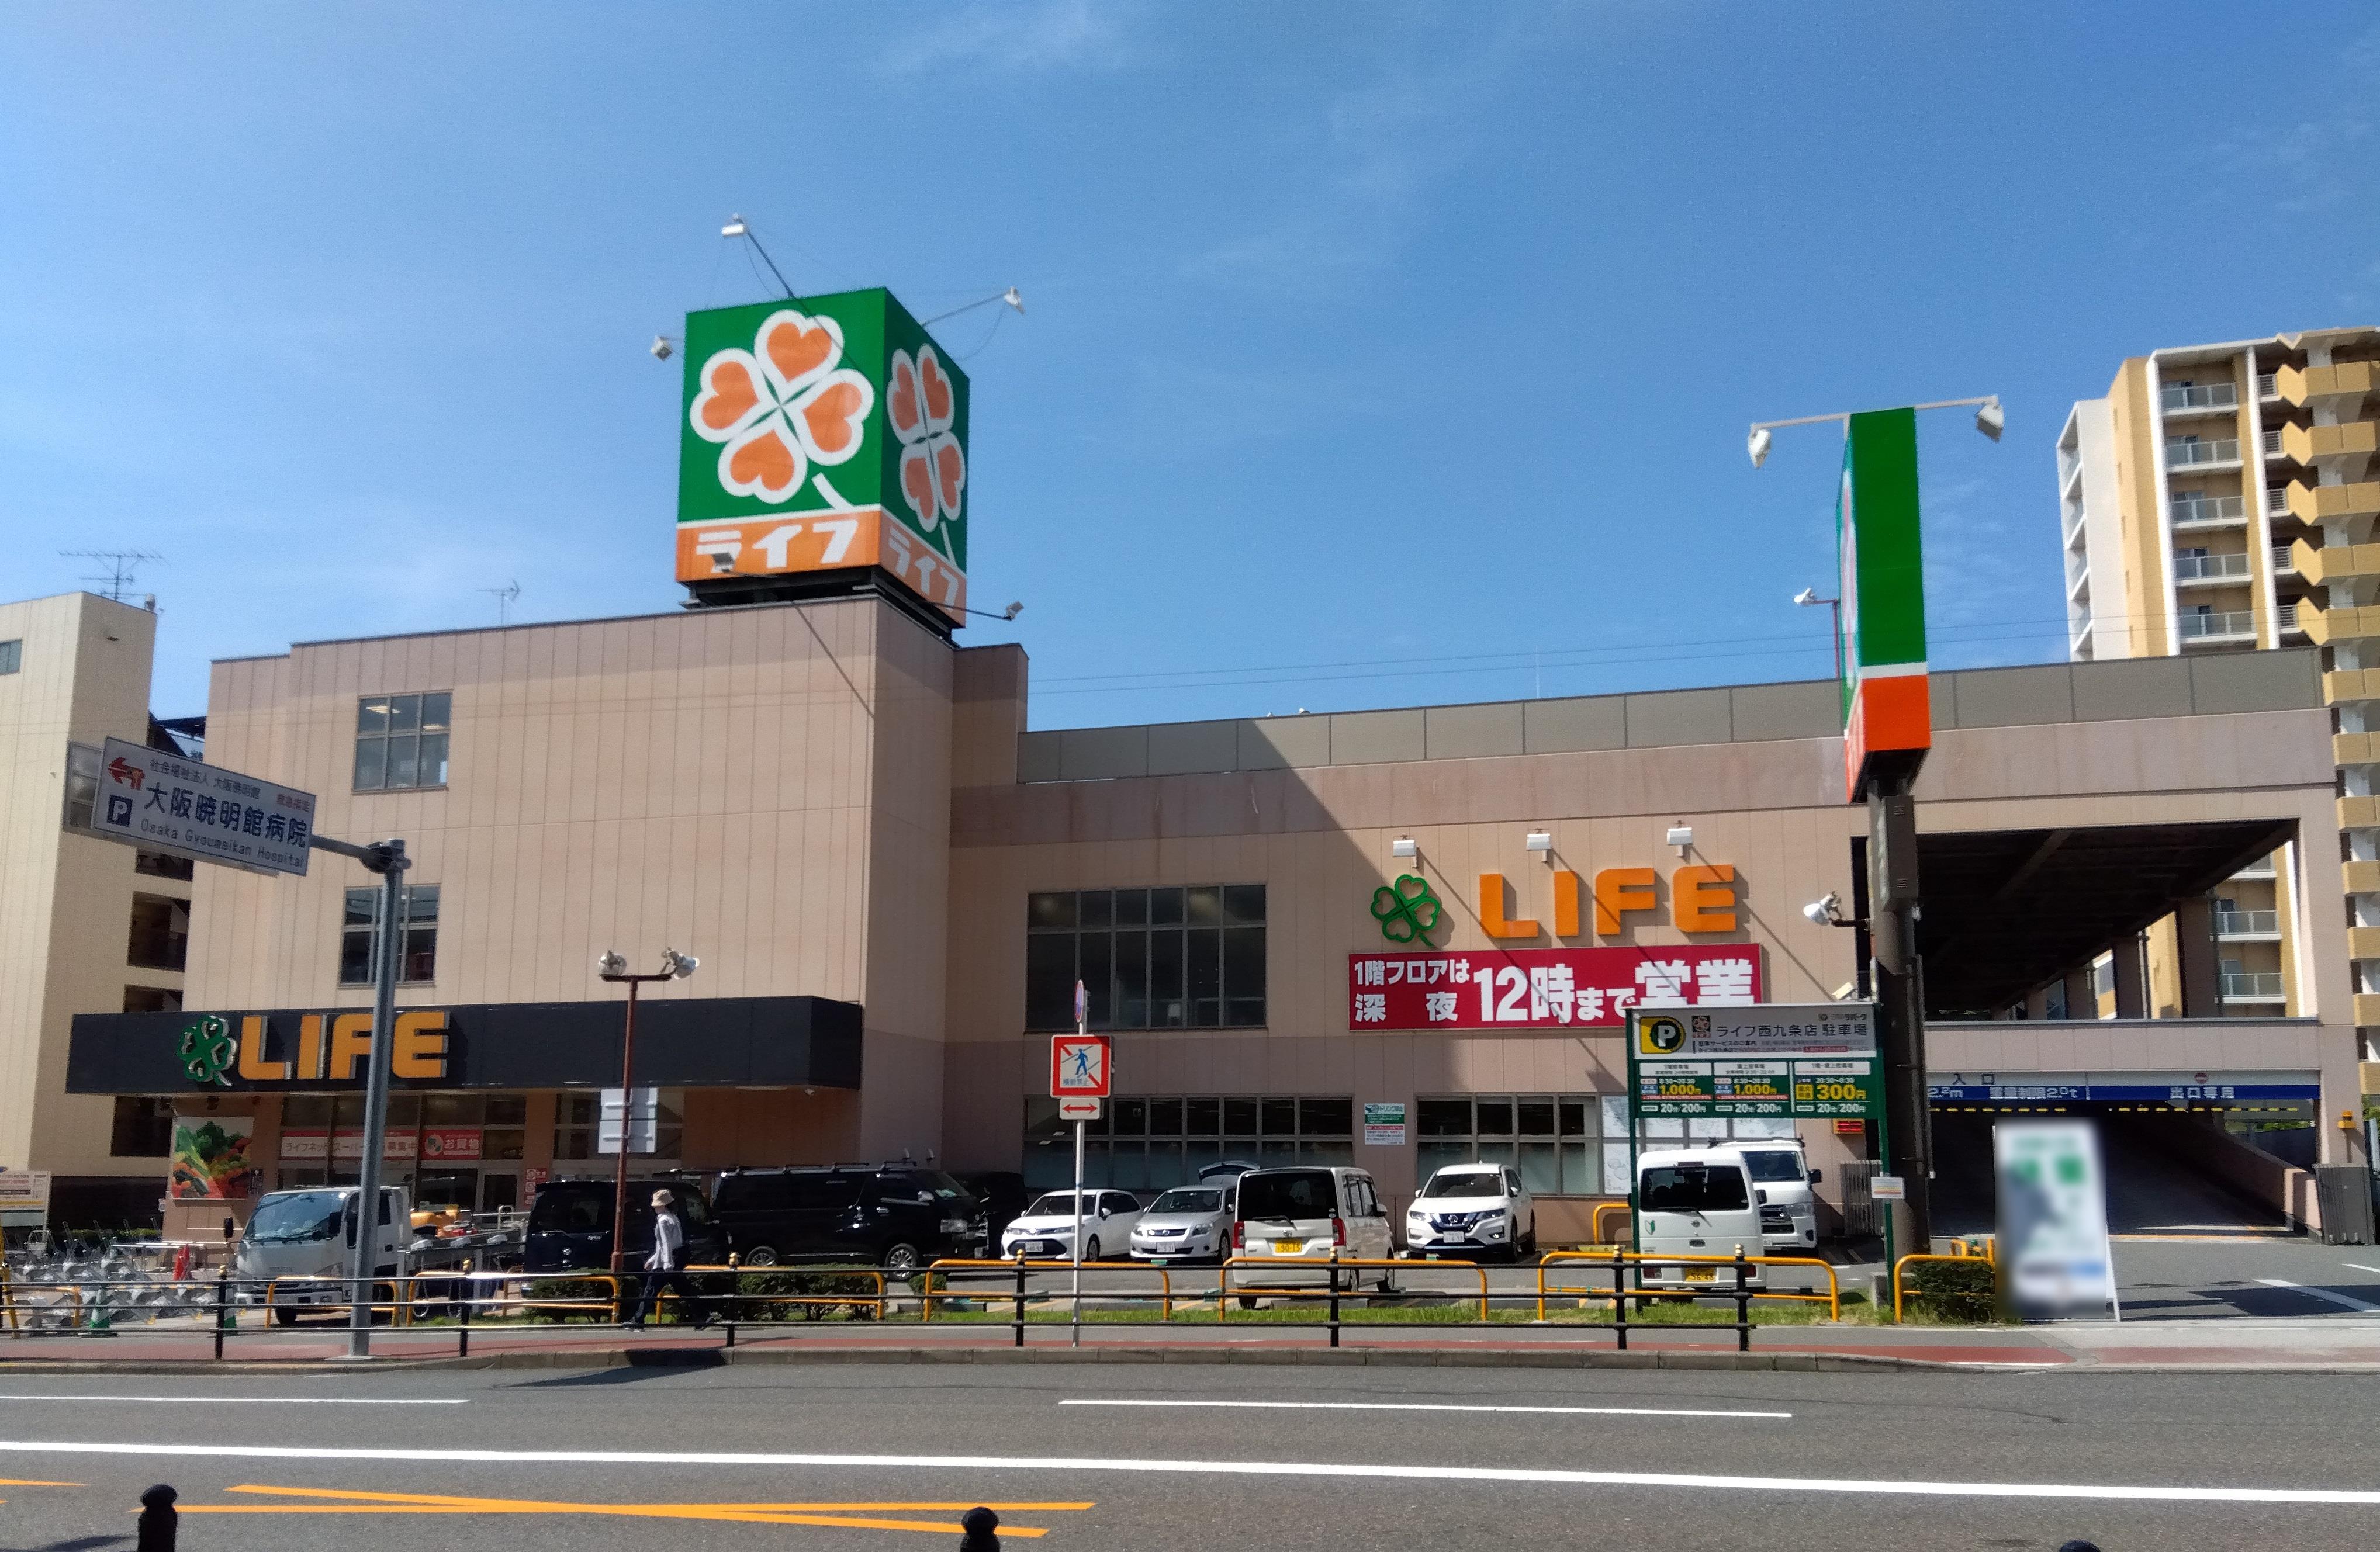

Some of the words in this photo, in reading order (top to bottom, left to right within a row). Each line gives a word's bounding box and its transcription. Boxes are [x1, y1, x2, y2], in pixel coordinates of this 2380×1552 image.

[696, 519, 858, 573] ライフ
[888, 529, 959, 611] ライフ
[141, 818, 178, 839] Osaka
[258, 847, 304, 867] Hospital
[1479, 864, 1736, 938] LIFE
[1354, 958, 1471, 986] 1階フロアは
[238, 1010, 450, 1080] LIFE
[1658, 1024, 1676, 1047] P
[1715, 1025, 1817, 1037] ライフ西九条店
[1822, 1024, 1867, 1036] 駐車場
[1816, 1084, 1866, 1100] 300円
[2170, 1087, 2235, 1099] 出口専用
